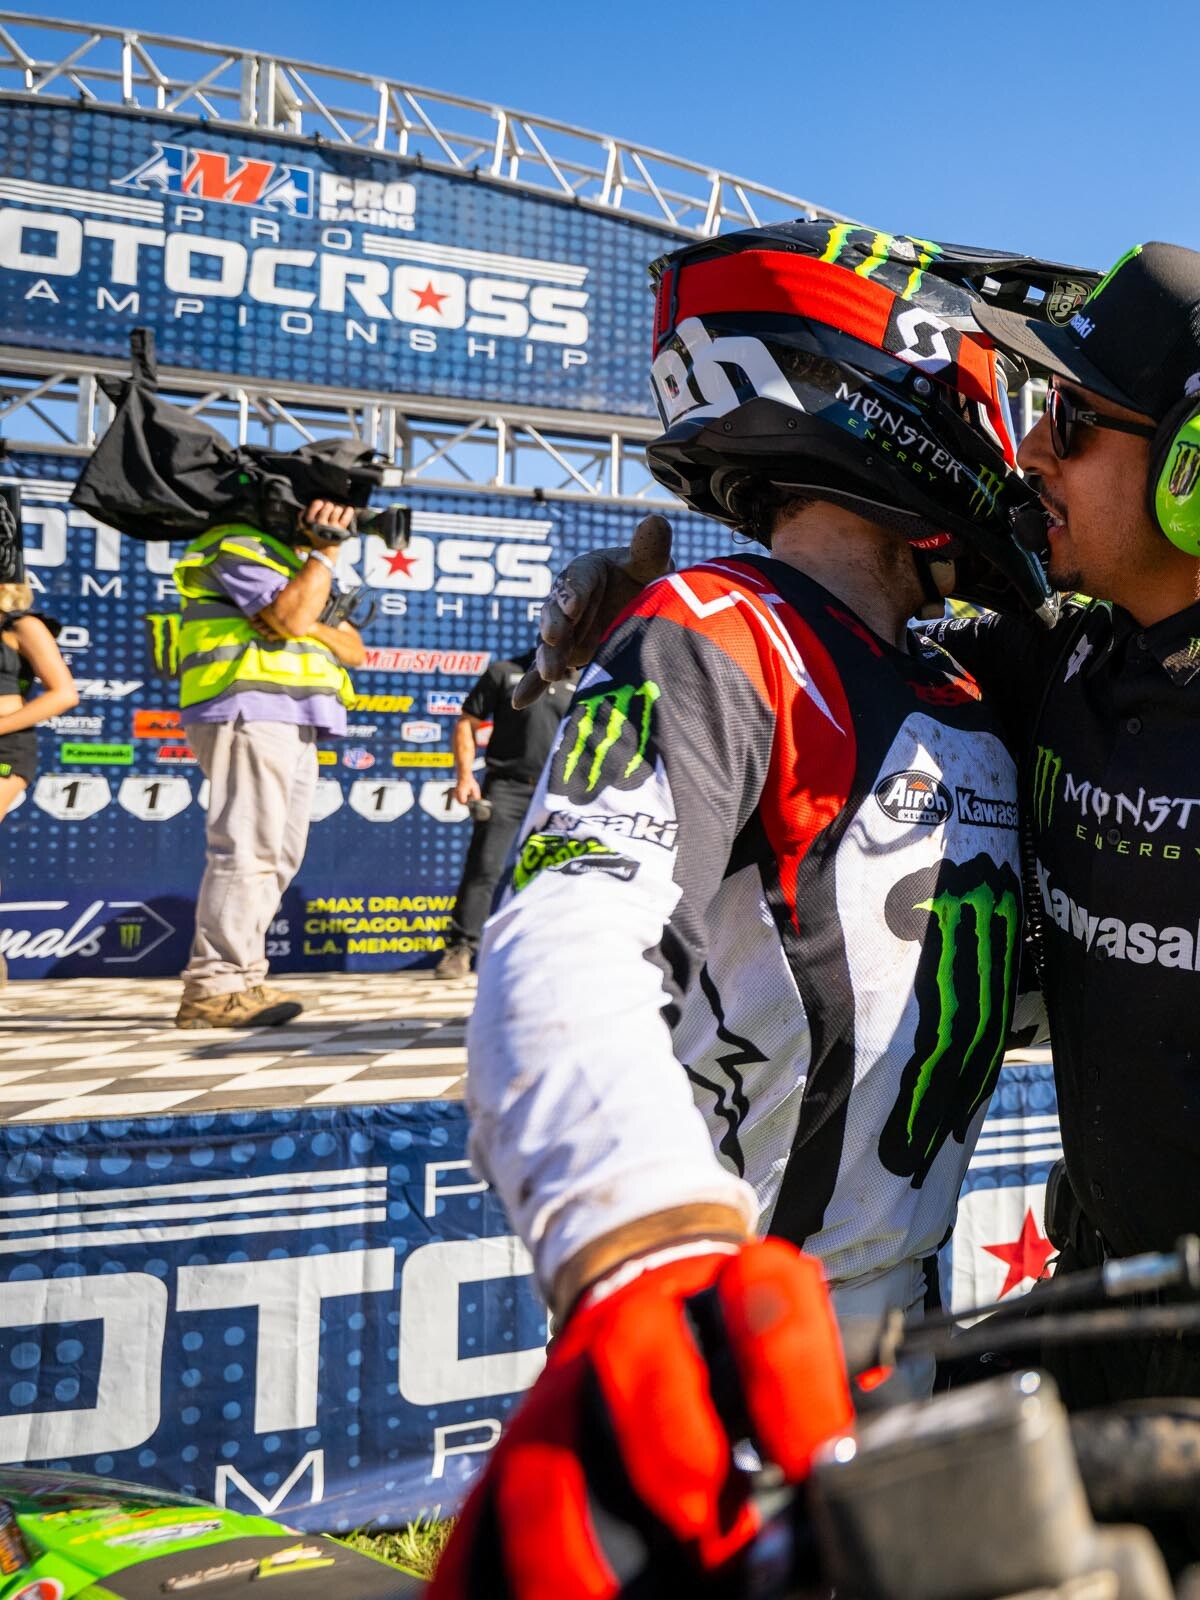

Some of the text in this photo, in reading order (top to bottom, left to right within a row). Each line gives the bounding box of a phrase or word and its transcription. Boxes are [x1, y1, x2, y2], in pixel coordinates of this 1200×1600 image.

[109, 140, 314, 219] AMA
[319, 171, 417, 216] PRO
[319, 205, 416, 232] RACING
[835, 382, 961, 483] MONSTER
[847, 417, 937, 482] ENERGY
[884, 778, 948, 812] Airoh
[347, 936, 452, 954] MEMORIA
